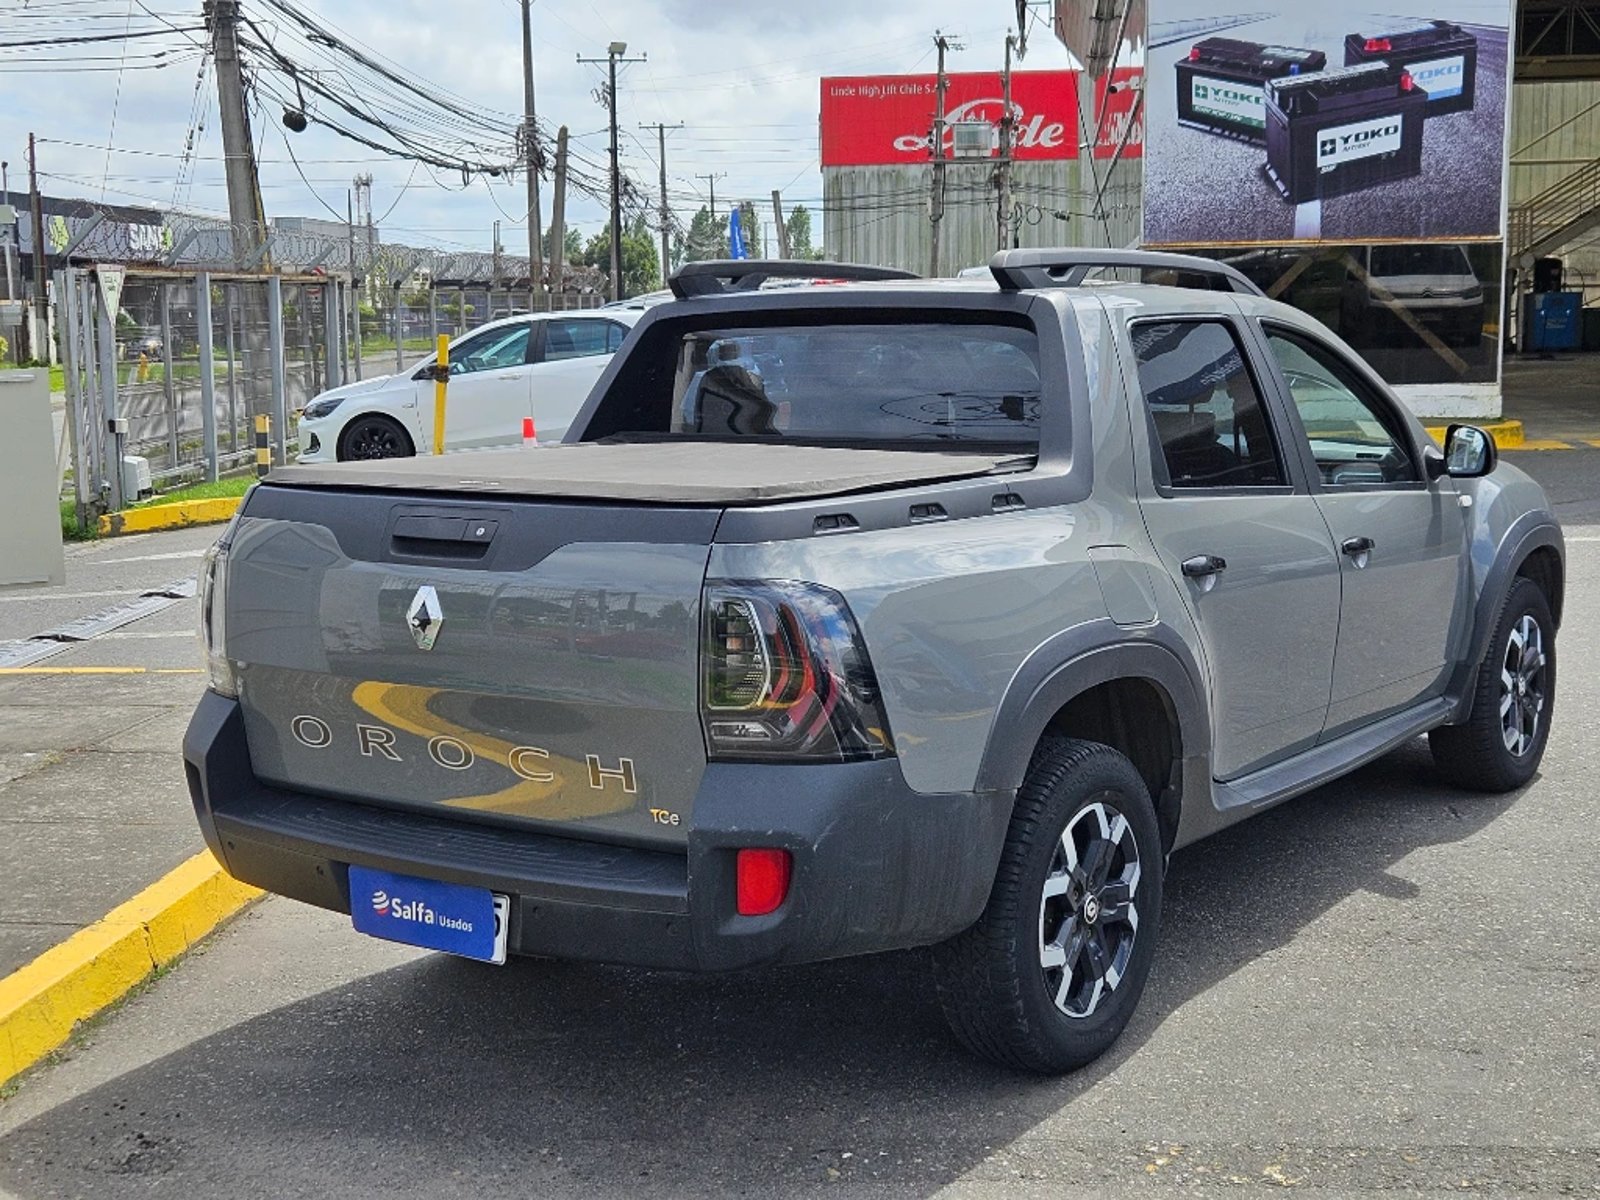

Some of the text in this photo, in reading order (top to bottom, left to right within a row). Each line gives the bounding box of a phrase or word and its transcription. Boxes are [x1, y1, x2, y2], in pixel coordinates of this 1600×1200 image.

[830, 86, 856, 97] Linde
[858, 85, 880, 98] High
[882, 84, 897, 95] Lift
[899, 83, 922, 94] Chile
[1339, 124, 1399, 145] YOKO
[291, 715, 637, 793] OROCH
[649, 808, 681, 826] TCe
[391, 897, 435, 925] Salfa
[438, 915, 473, 933] Usados
